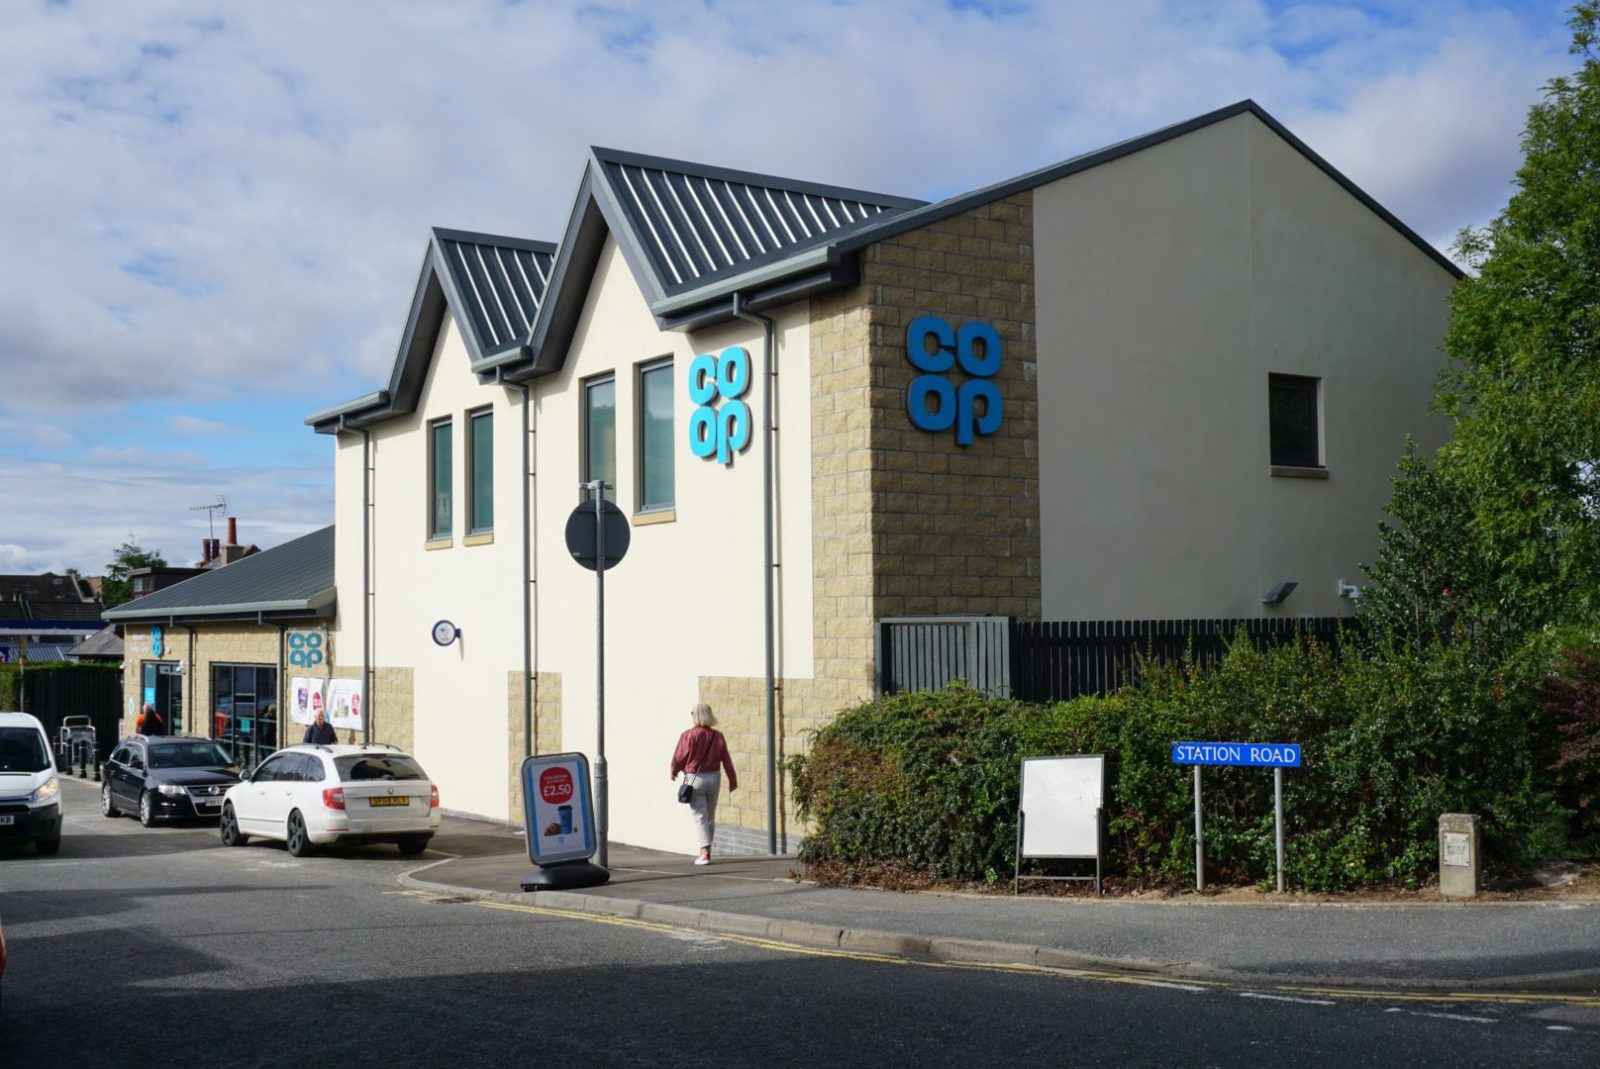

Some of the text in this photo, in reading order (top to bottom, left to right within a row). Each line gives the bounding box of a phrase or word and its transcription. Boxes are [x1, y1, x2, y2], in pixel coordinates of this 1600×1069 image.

[688, 346, 751, 405] co
[906, 316, 1002, 376] co
[689, 400, 750, 464] op
[907, 374, 1004, 445] op
[1177, 746, 1296, 763] STATION ROAD
[543, 783, 571, 797] £2.50
